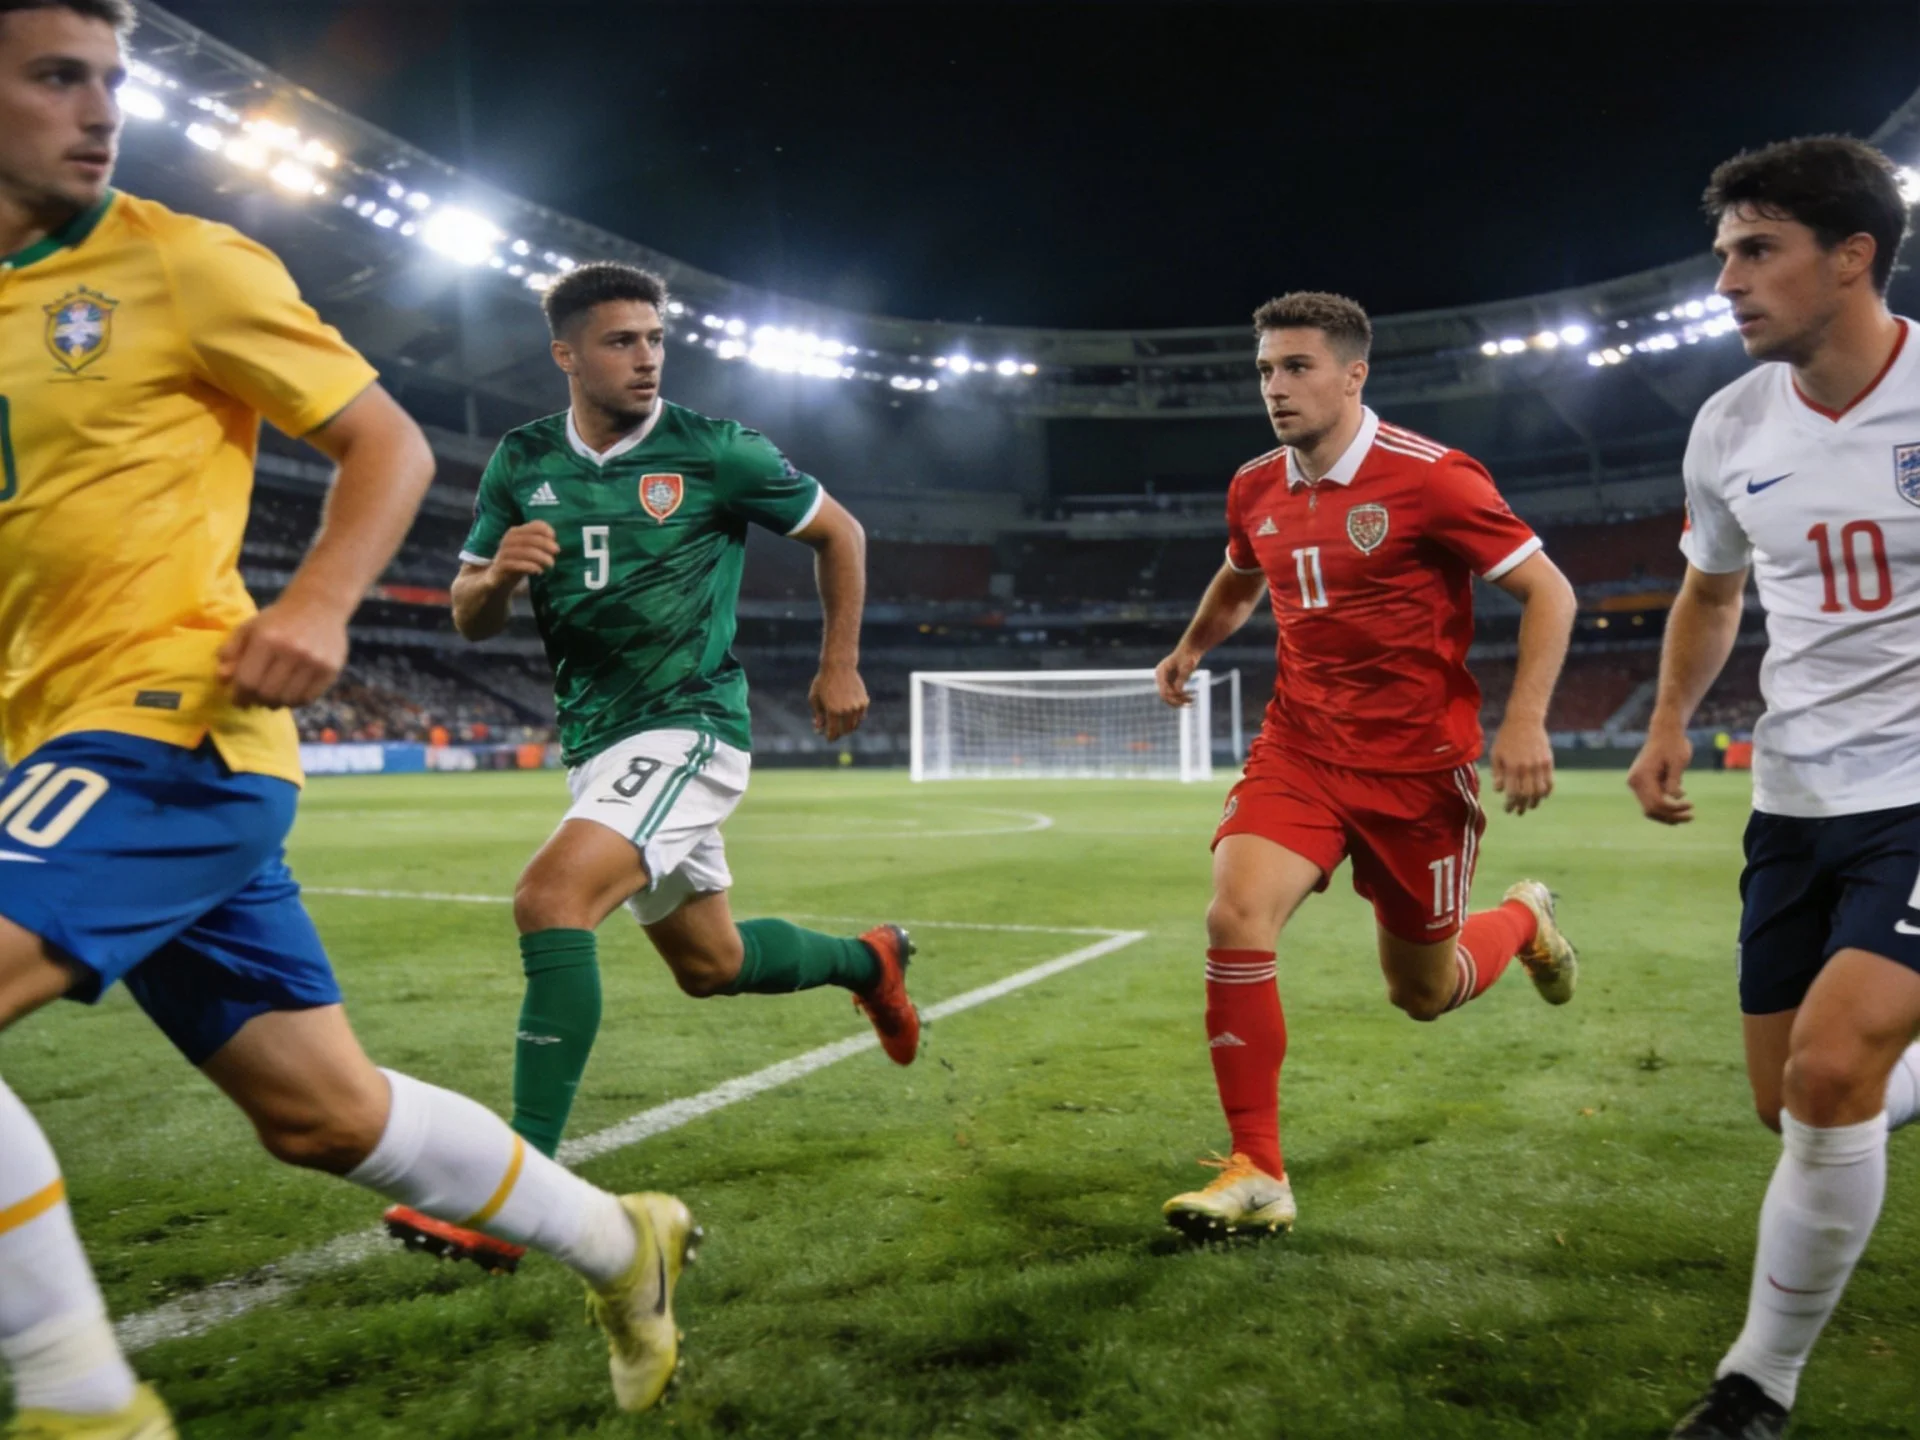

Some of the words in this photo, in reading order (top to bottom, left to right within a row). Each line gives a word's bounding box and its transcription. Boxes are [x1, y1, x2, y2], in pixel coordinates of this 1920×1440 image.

[1292, 546, 1328, 608] 11
[1807, 519, 1893, 613] 10
[0, 762, 110, 848] 10
[612, 756, 661, 797] 8
[1428, 854, 1455, 916] 11
